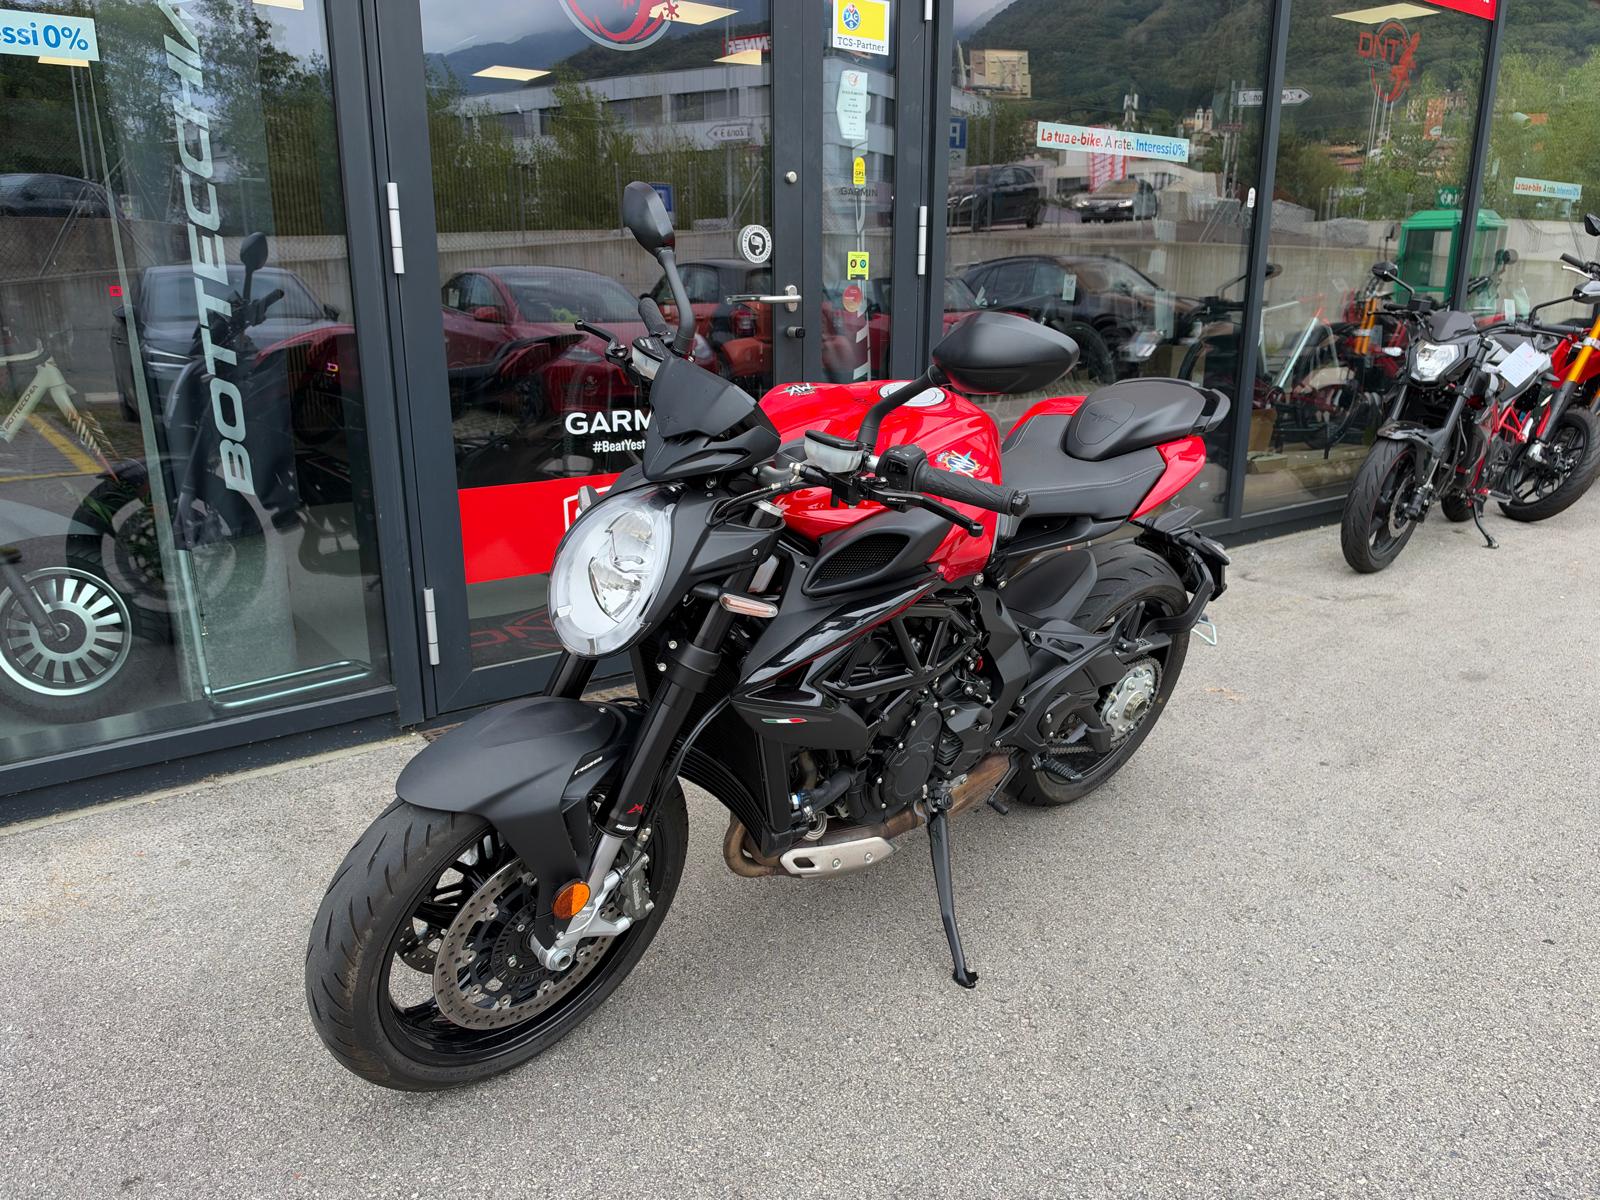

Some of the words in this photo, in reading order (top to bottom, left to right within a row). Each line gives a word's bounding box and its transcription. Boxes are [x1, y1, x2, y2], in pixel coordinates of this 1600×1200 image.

[43, 25, 89, 51] 0%
[837, 36, 885, 52] TCS-Partner
[1041, 128, 1052, 142] La
[1054, 131, 1072, 144] tua
[1071, 131, 1103, 147] e-bike.
[1105, 136, 1112, 148] A
[1114, 138, 1134, 151] rate.
[1136, 139, 1172, 155] Interessi
[1173, 143, 1186, 157] 0%
